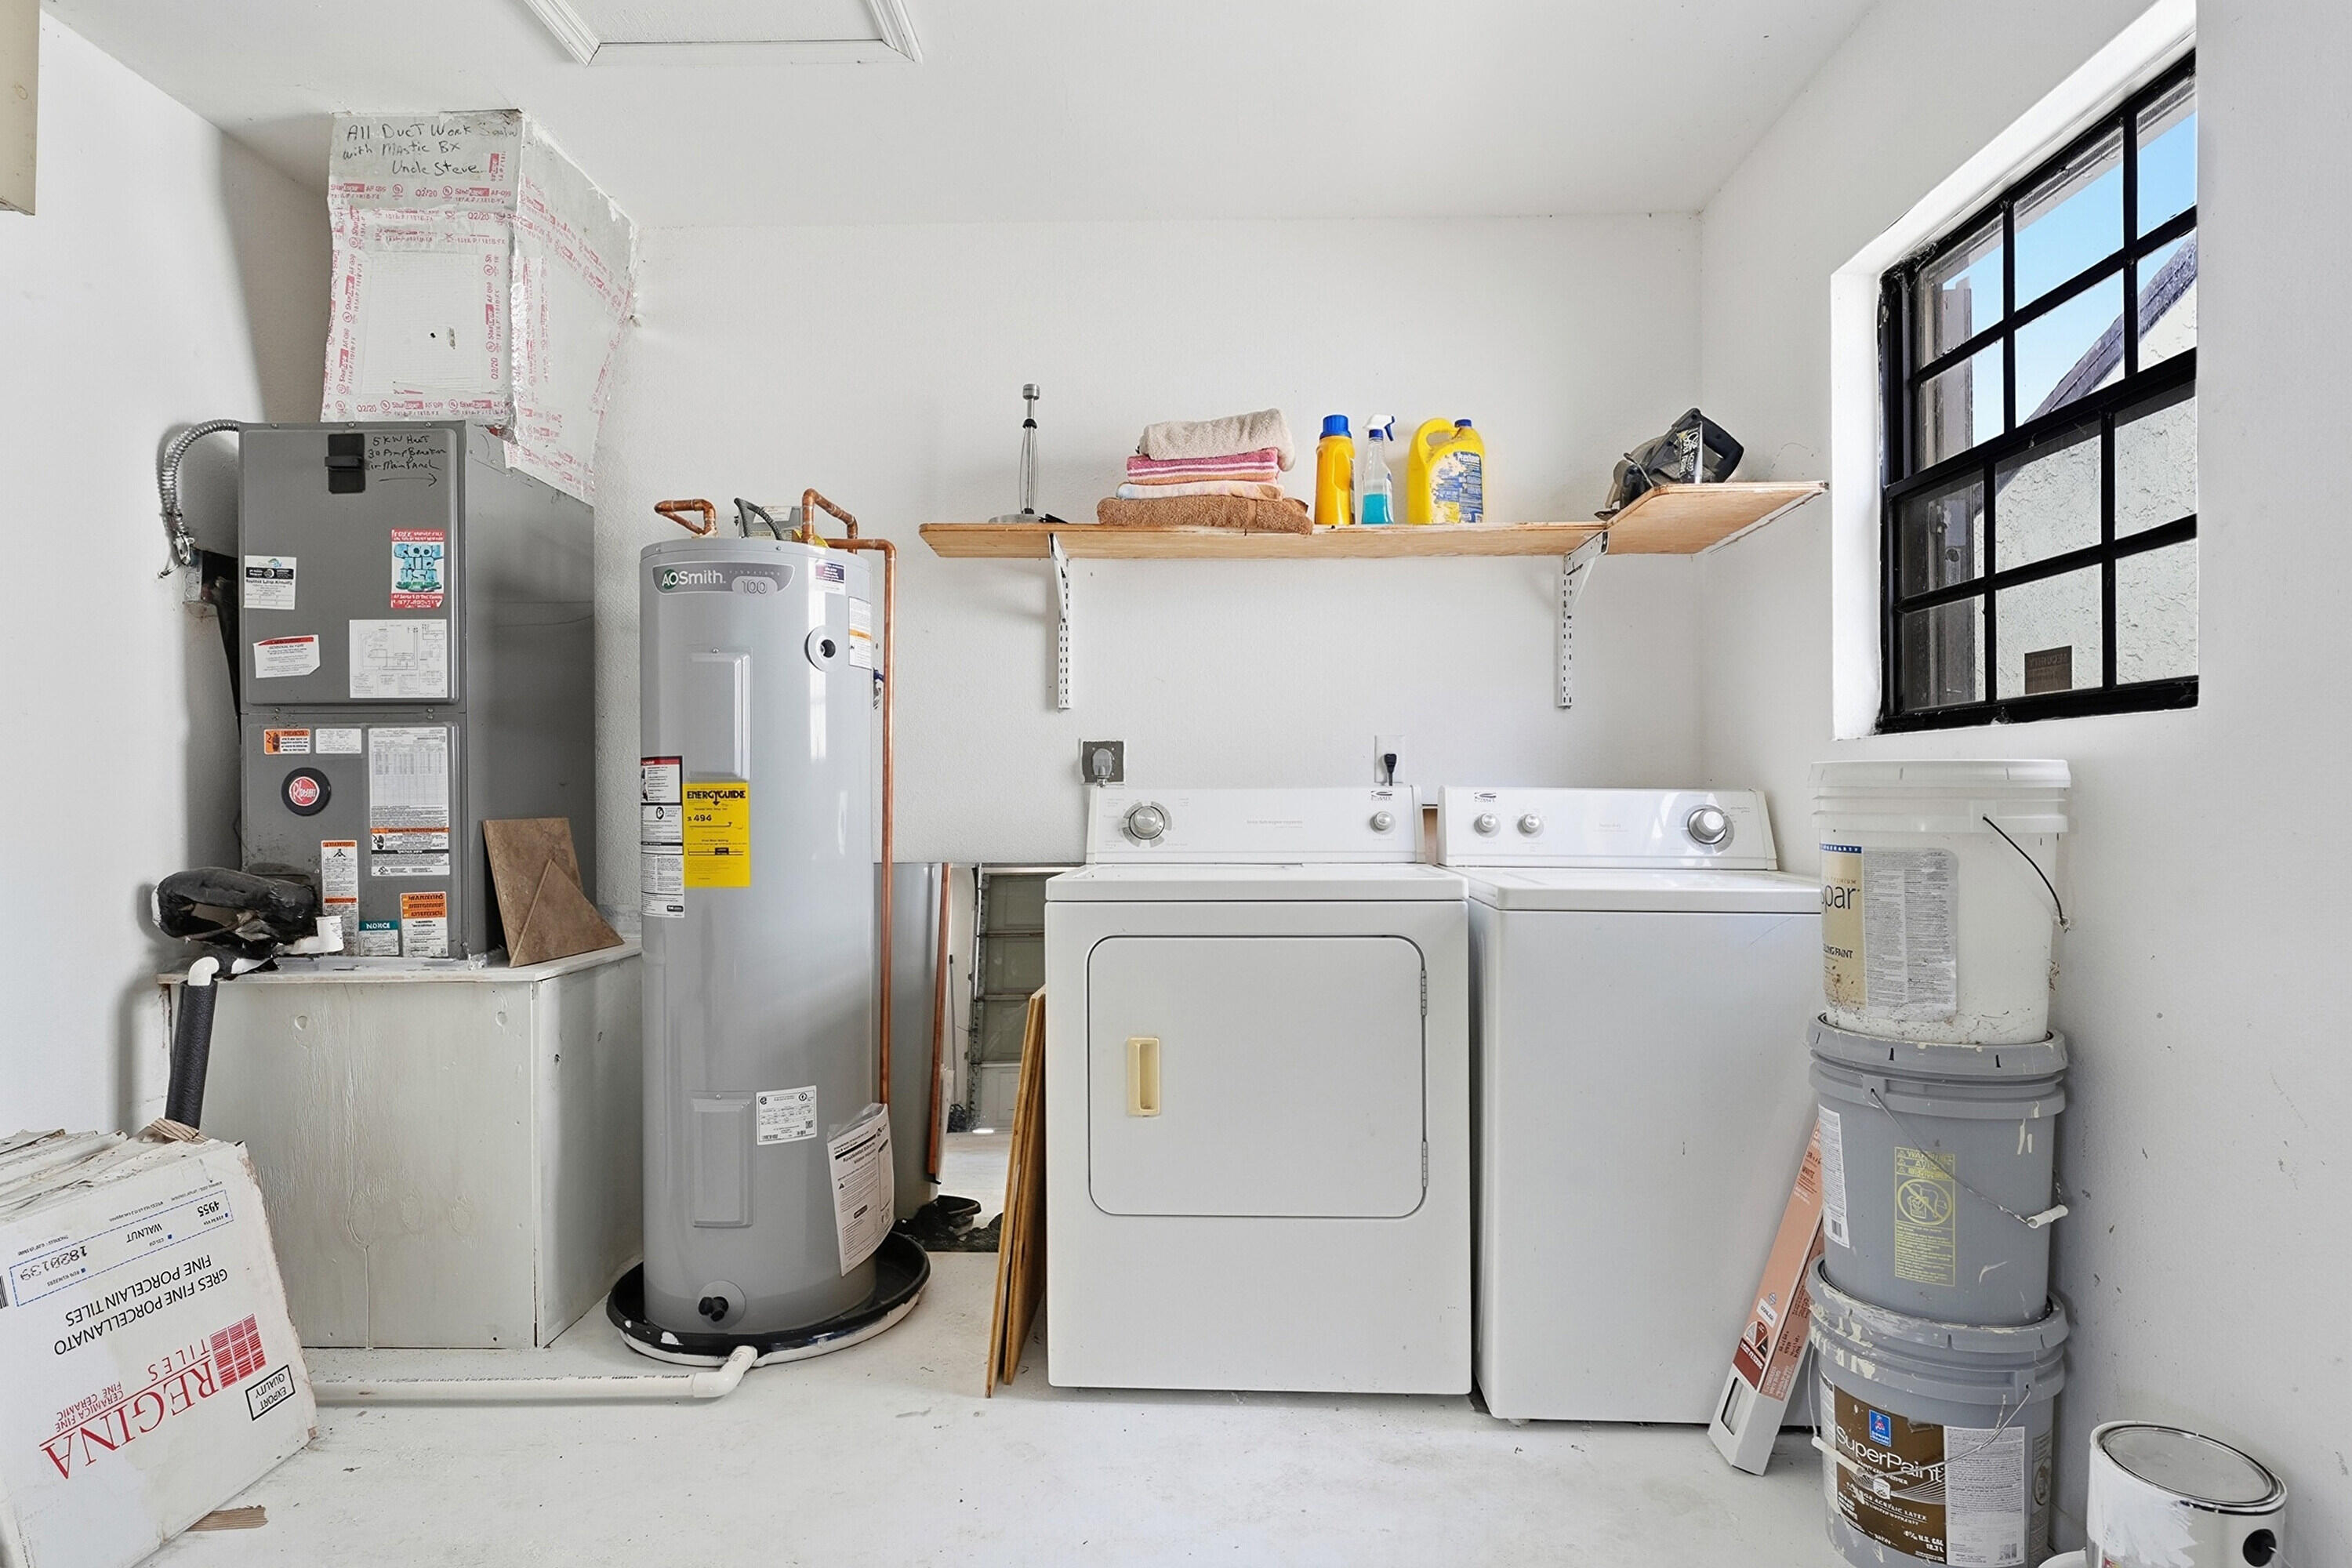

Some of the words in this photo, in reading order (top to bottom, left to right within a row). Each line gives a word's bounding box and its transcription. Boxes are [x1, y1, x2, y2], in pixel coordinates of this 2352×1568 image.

[347, 125, 370, 141] All
[343, 143, 373, 160] with
[392, 160, 430, 175] Uncle
[742, 580, 766, 594] 100
[197, 1200, 220, 1218] 4955
[126, 1223, 162, 1243] WALNUT
[183, 1254, 212, 1276] FINE
[105, 1266, 180, 1309] PORCELAIN
[198, 1269, 228, 1292] GRES
[165, 1282, 195, 1306] FINE
[65, 1300, 105, 1327] TILES
[54, 1295, 163, 1356] PORCELLANATO
[147, 1339, 210, 1381] TILES
[102, 1381, 122, 1397] FINE
[256, 1373, 285, 1398] QUALITY
[56, 1393, 97, 1421] CERAMIC
[78, 1391, 124, 1420] CERAMICA
[260, 1386, 287, 1411] EXPORT
[42, 1359, 219, 1479] REGINA
[55, 1414, 76, 1432] FINE
